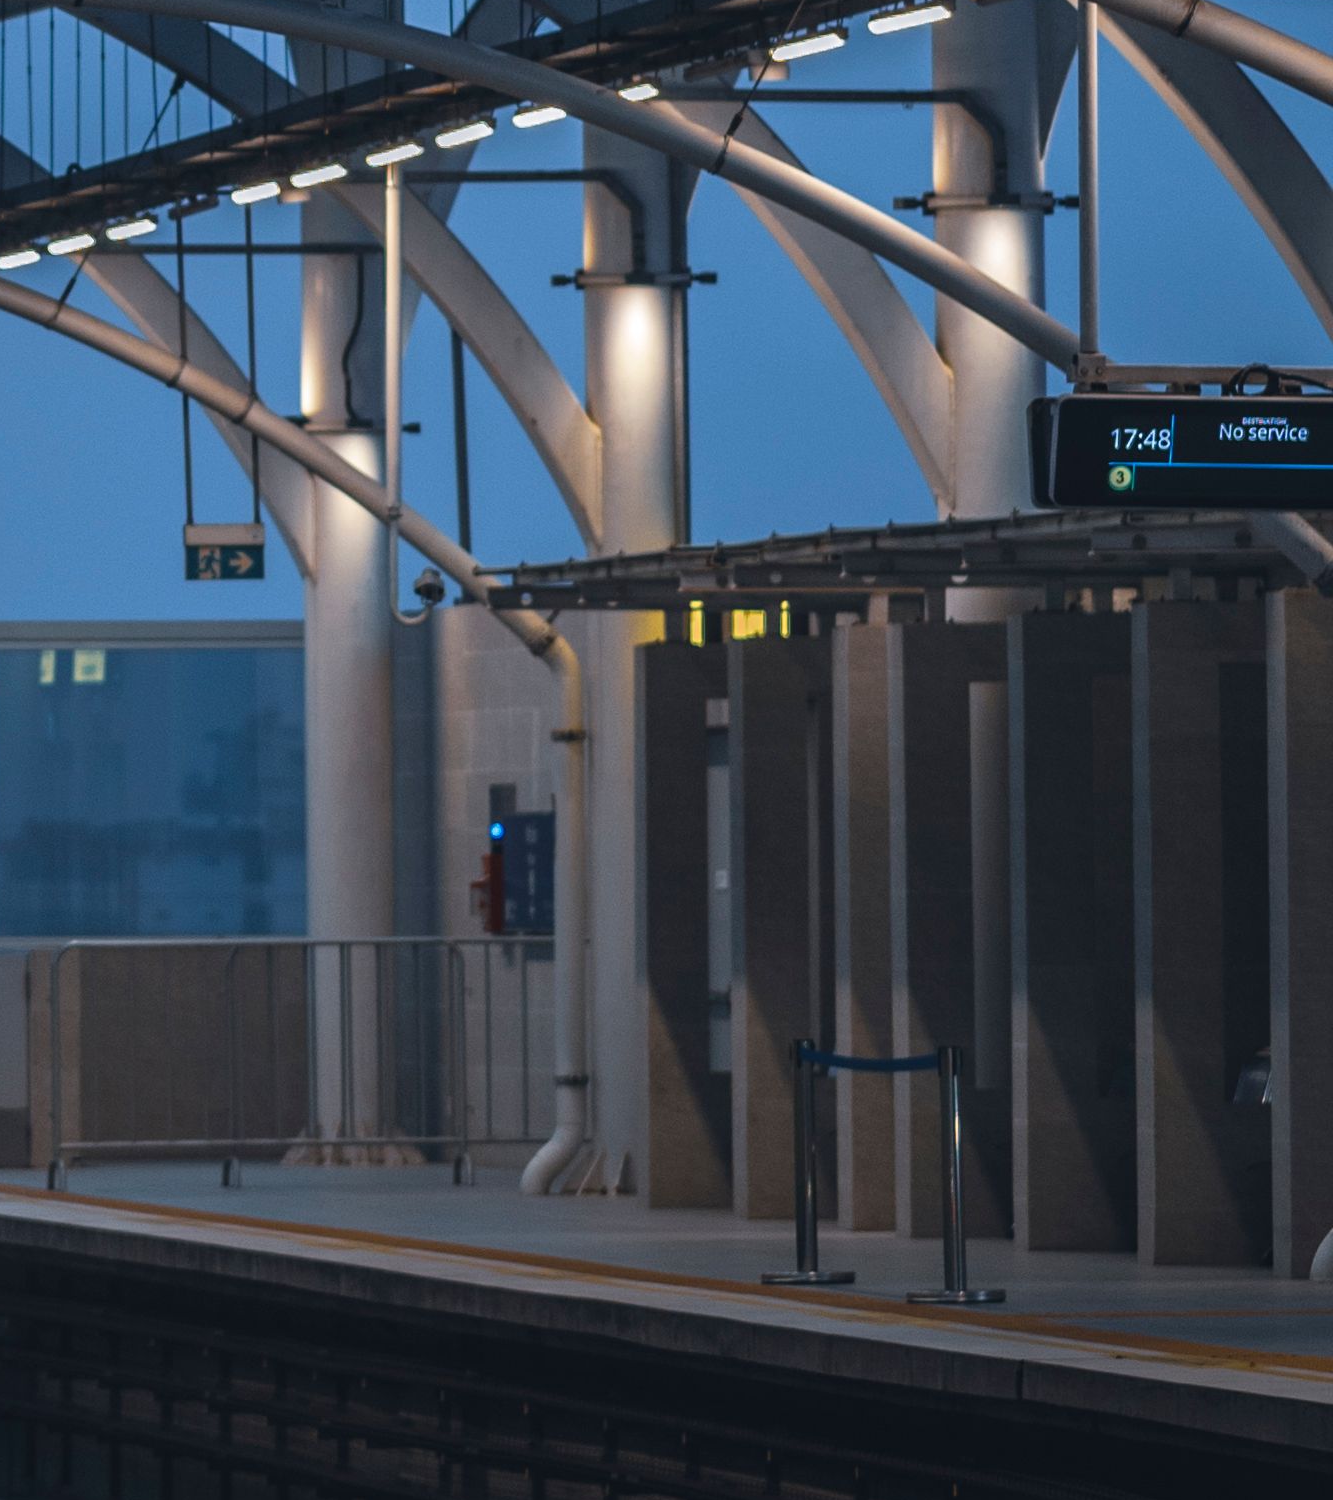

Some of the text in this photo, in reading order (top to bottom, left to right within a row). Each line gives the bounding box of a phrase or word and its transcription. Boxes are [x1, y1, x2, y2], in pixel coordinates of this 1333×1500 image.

[1110, 428, 1172, 450] 17:48
[1219, 422, 1309, 442] No service
[1115, 470, 1126, 484] 3
